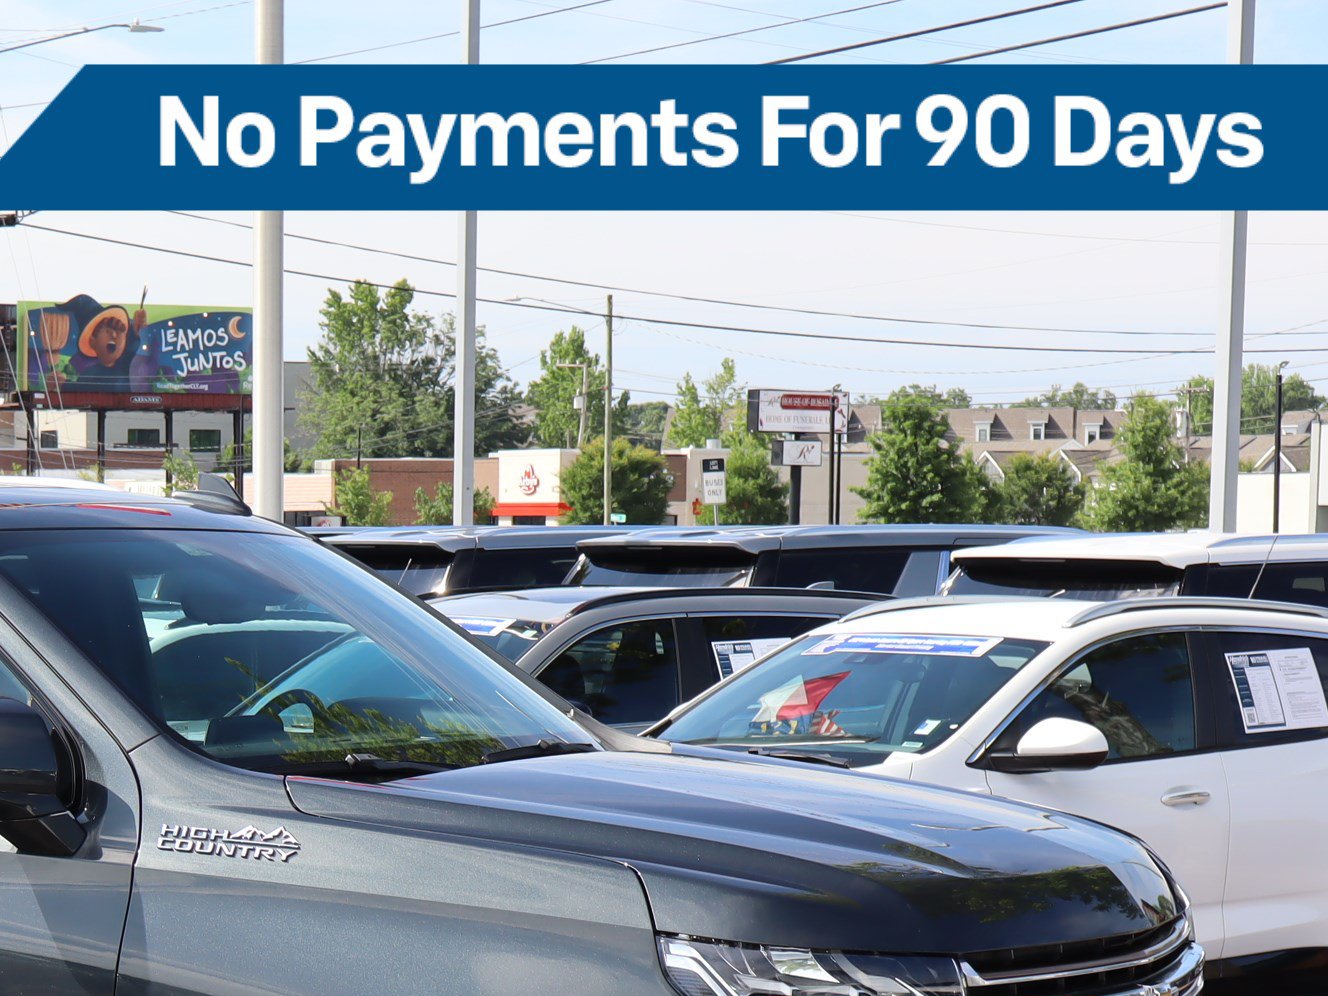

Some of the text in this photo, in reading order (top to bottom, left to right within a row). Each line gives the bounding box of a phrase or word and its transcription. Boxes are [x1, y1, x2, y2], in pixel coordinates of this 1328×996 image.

[160, 327, 229, 352] LEAMOS
[172, 350, 247, 377] JUNTOS
[160, 823, 232, 842] HIGH
[156, 836, 298, 863] COUNTRY
